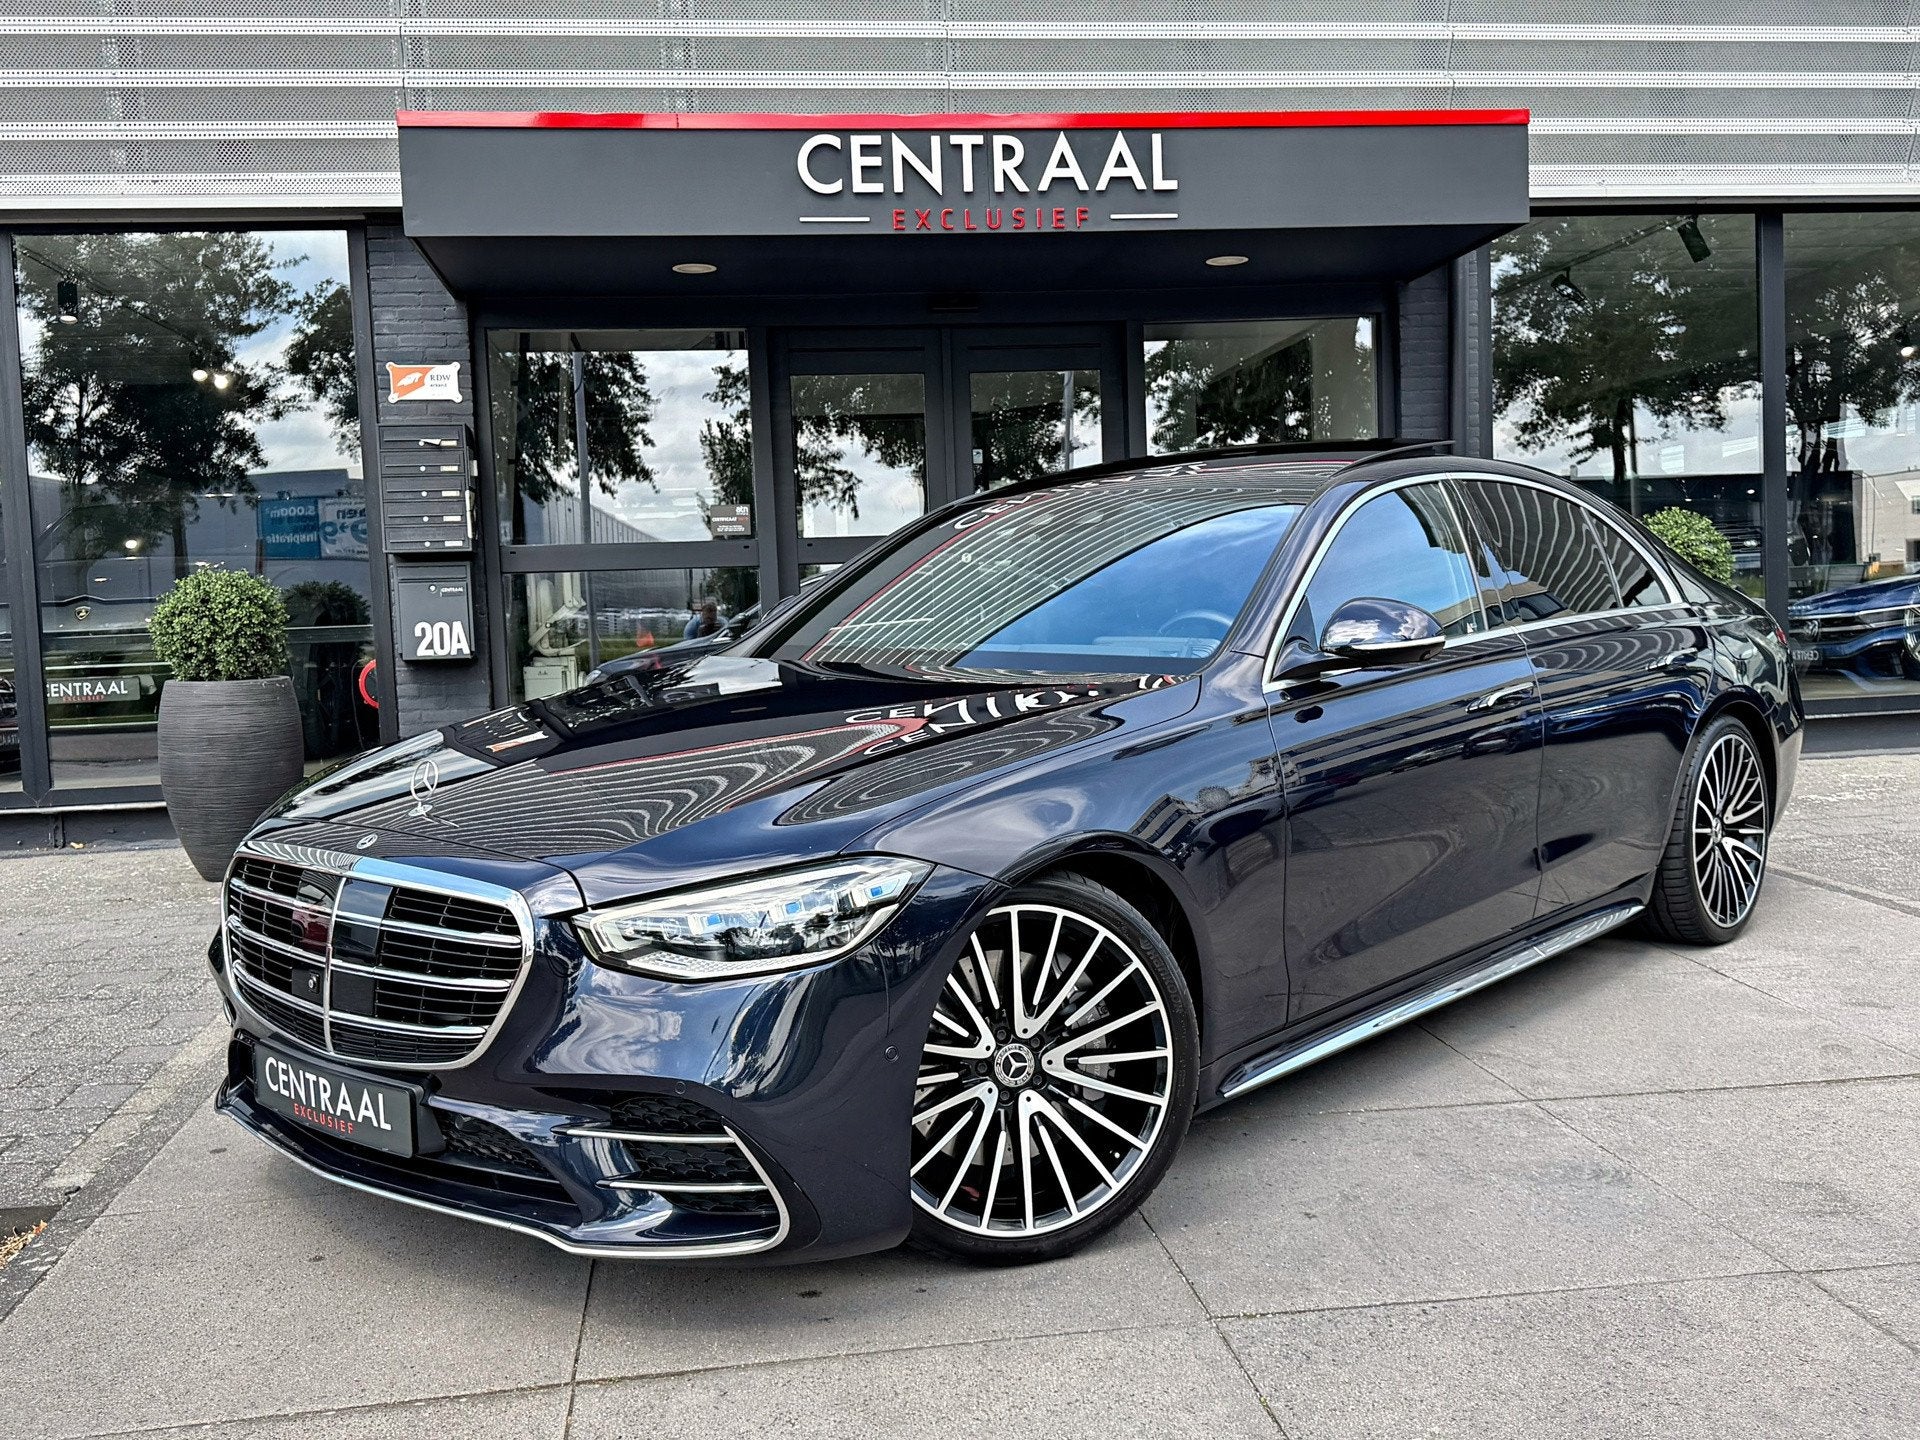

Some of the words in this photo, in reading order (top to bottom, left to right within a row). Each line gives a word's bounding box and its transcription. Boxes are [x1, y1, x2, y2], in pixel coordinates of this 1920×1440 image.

[797, 130, 1179, 196] CENTRAAL
[892, 207, 1090, 231] EXCLUSIEF
[414, 621, 471, 657] 20A
[265, 1056, 391, 1131] CENTRAAL
[293, 1103, 354, 1135] EXCLUSIEF
